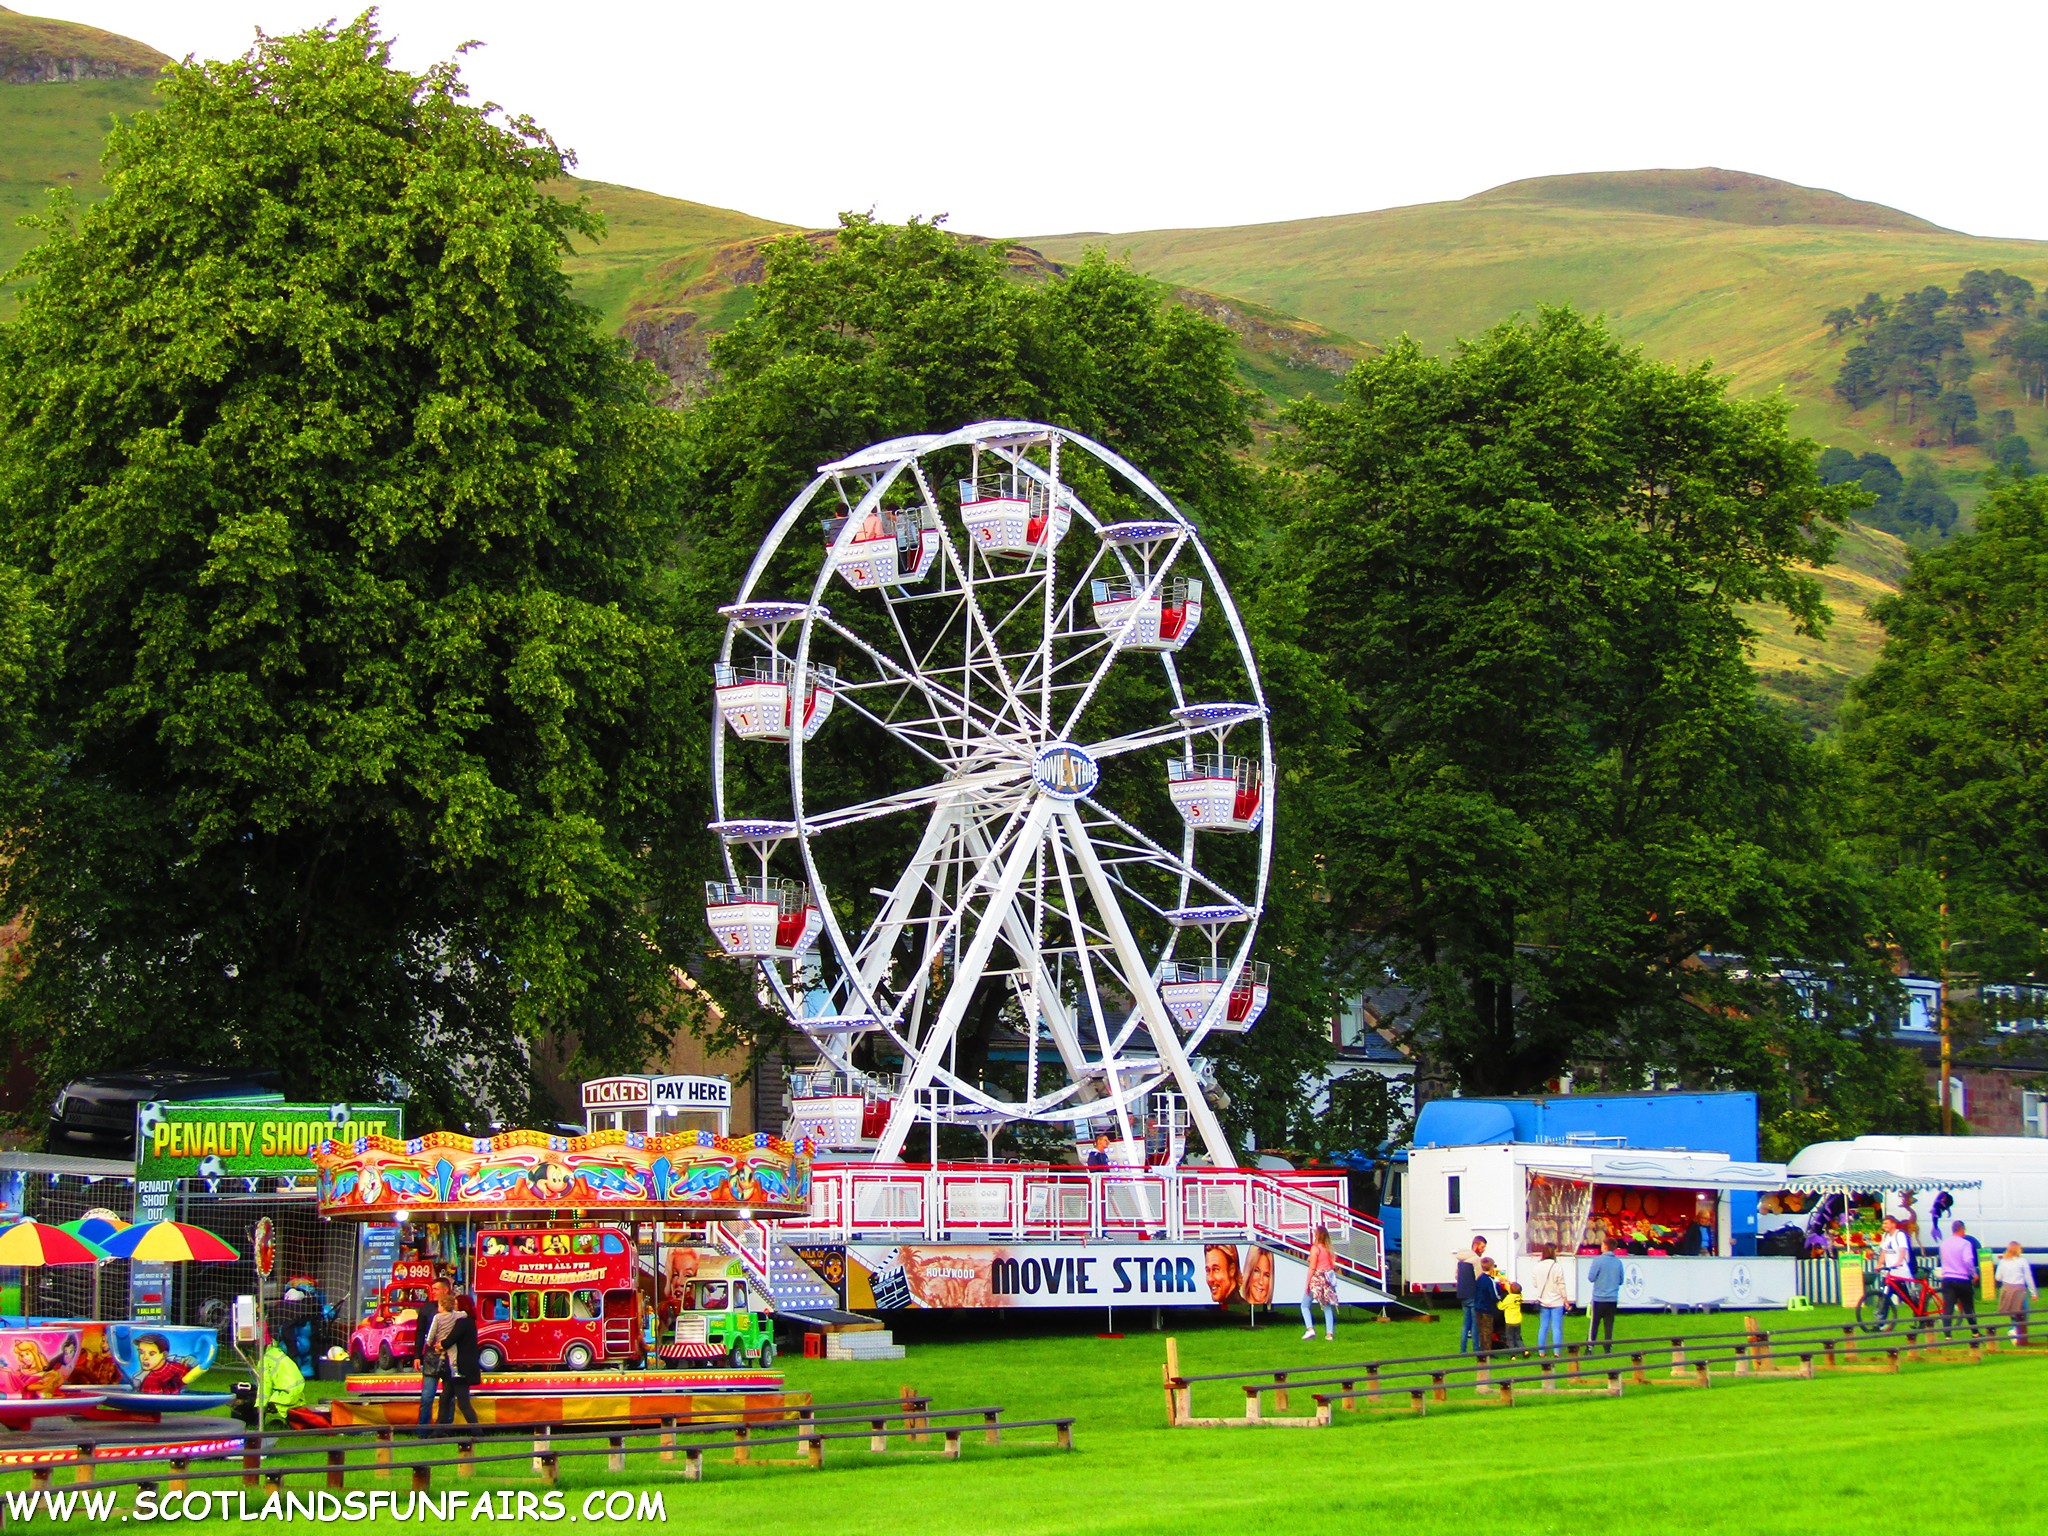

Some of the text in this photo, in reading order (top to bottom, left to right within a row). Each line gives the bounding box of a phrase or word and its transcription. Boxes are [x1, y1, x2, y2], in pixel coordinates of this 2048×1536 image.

[982, 528, 992, 540] 3
[854, 569, 865, 580] 2
[740, 713, 748, 726] 1
[1191, 805, 1200, 817] 5
[730, 933, 740, 945] 5
[1185, 1008, 1193, 1020] 1
[586, 1081, 727, 1102] TICKETS PAY HERE
[816, 1125, 825, 1137] 4
[153, 1121, 256, 1157] PENALTY
[261, 1121, 337, 1157] SHOOT
[138, 1180, 174, 1193] PENALTY
[142, 1194, 168, 1206] SHOOT
[147, 1208, 163, 1221] OUT
[410, 1265, 430, 1278] 999
[499, 1267, 607, 1284] ENTERTAINMENT
[926, 1267, 975, 1280] HOLLYWOOD
[991, 1256, 1196, 1295] MOVIE STAR
